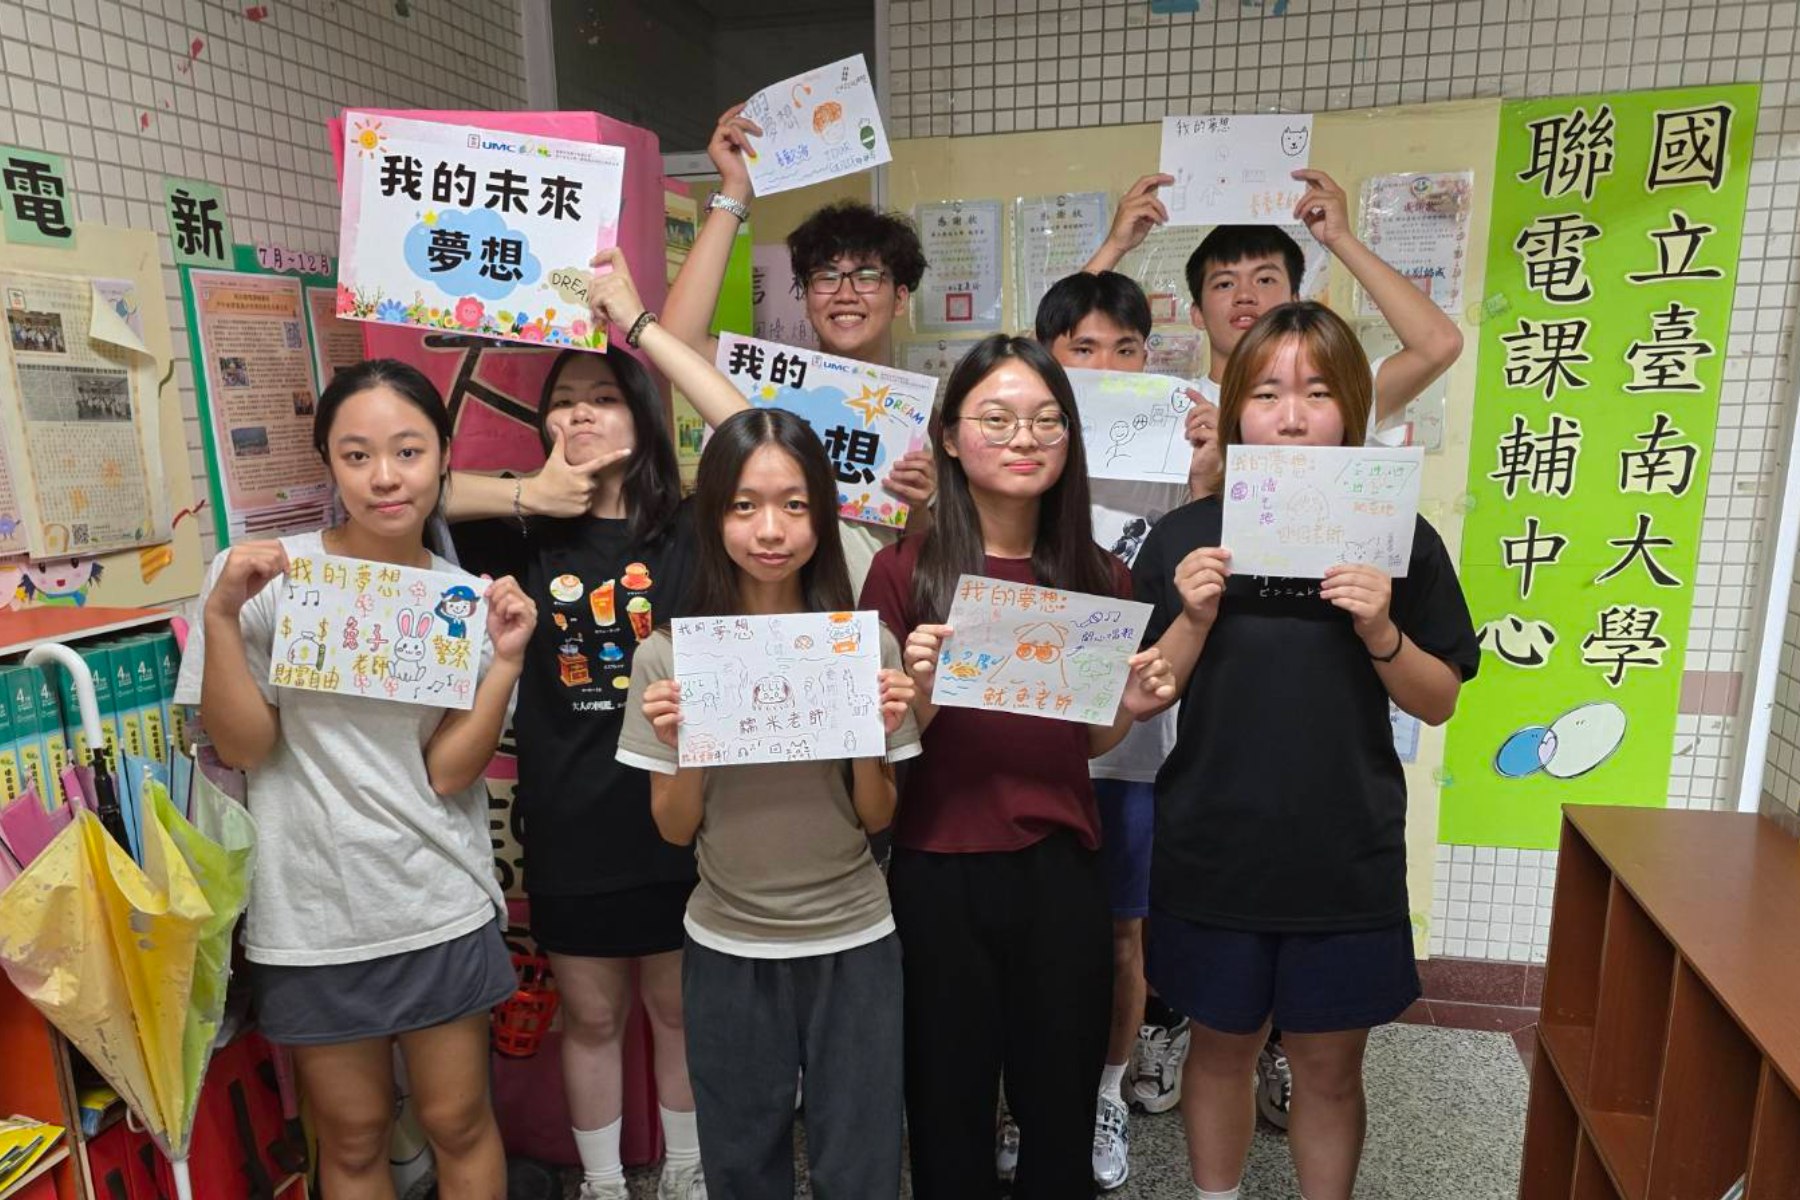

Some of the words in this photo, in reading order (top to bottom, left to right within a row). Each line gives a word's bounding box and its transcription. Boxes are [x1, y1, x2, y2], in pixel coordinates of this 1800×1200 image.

[482, 141, 517, 154] UMC
[2, 157, 72, 238] 電
[379, 154, 584, 222] 我的未來
[170, 188, 225, 261] 新
[426, 228, 525, 282] 夢想
[551, 272, 590, 303] DREA
[728, 342, 808, 389] 我的
[823, 361, 850, 372] UMC
[1476, 106, 1615, 666] 聯電課輔中心
[883, 396, 925, 425] DREAM
[1582, 105, 1732, 685] 國立臺南大學
[290, 556, 401, 598] 我的夢想
[272, 663, 341, 691] 財富自由
[352, 654, 389, 681] 老師
